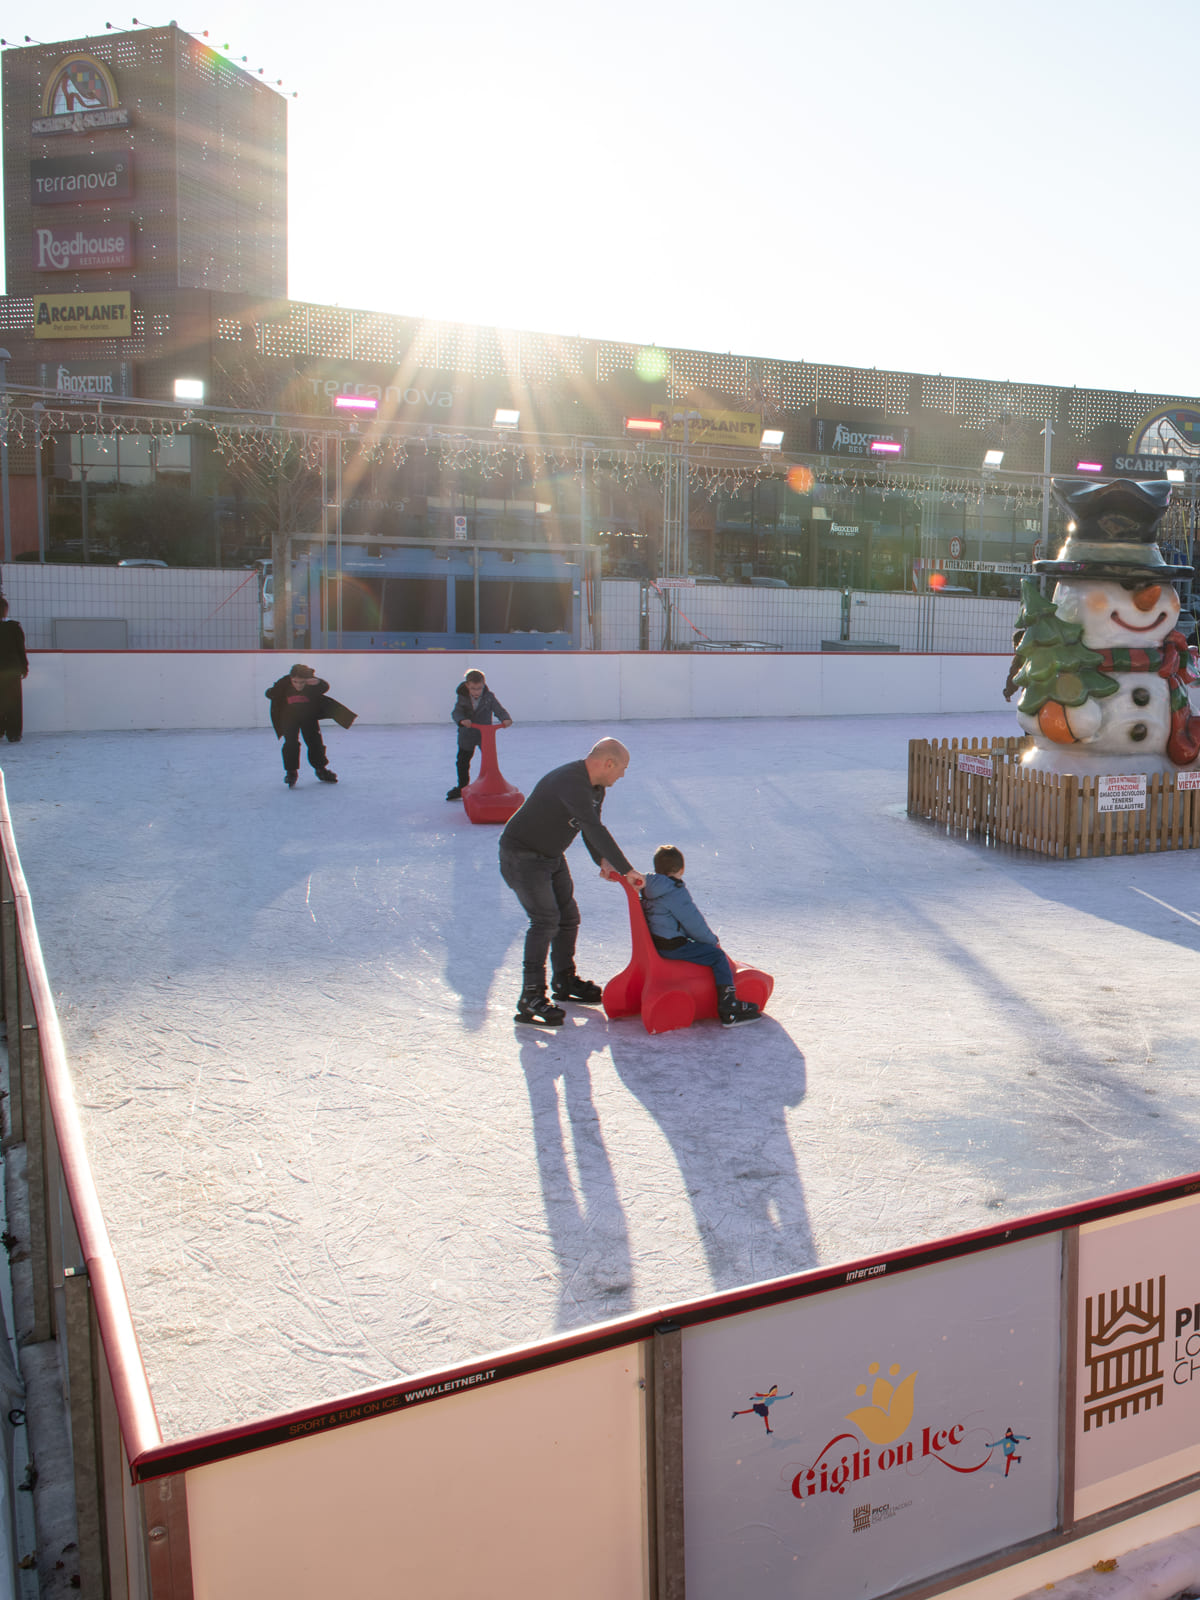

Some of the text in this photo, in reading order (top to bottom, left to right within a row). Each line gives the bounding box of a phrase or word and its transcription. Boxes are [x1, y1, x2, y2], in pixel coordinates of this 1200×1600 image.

[36, 229, 125, 269] Roadhouse
[80, 255, 125, 265] RESTAURANT
[36, 303, 126, 325] ARCAPLANET
[63, 375, 114, 393] BOXEUR
[944, 560, 975, 569] ATTENZIONE
[1121, 789, 1145, 797] SCIVOLOSO
[405, 1369, 497, 1403] WWW.LEITNER.IT
[289, 1418, 327, 1435] SPORT
[329, 1414, 337, 1425] &
[339, 1407, 361, 1422] FUN
[363, 1402, 380, 1415] ON
[791, 1424, 972, 1500] Gigli on Ice
[872, 1503, 889, 1515] PICCI
